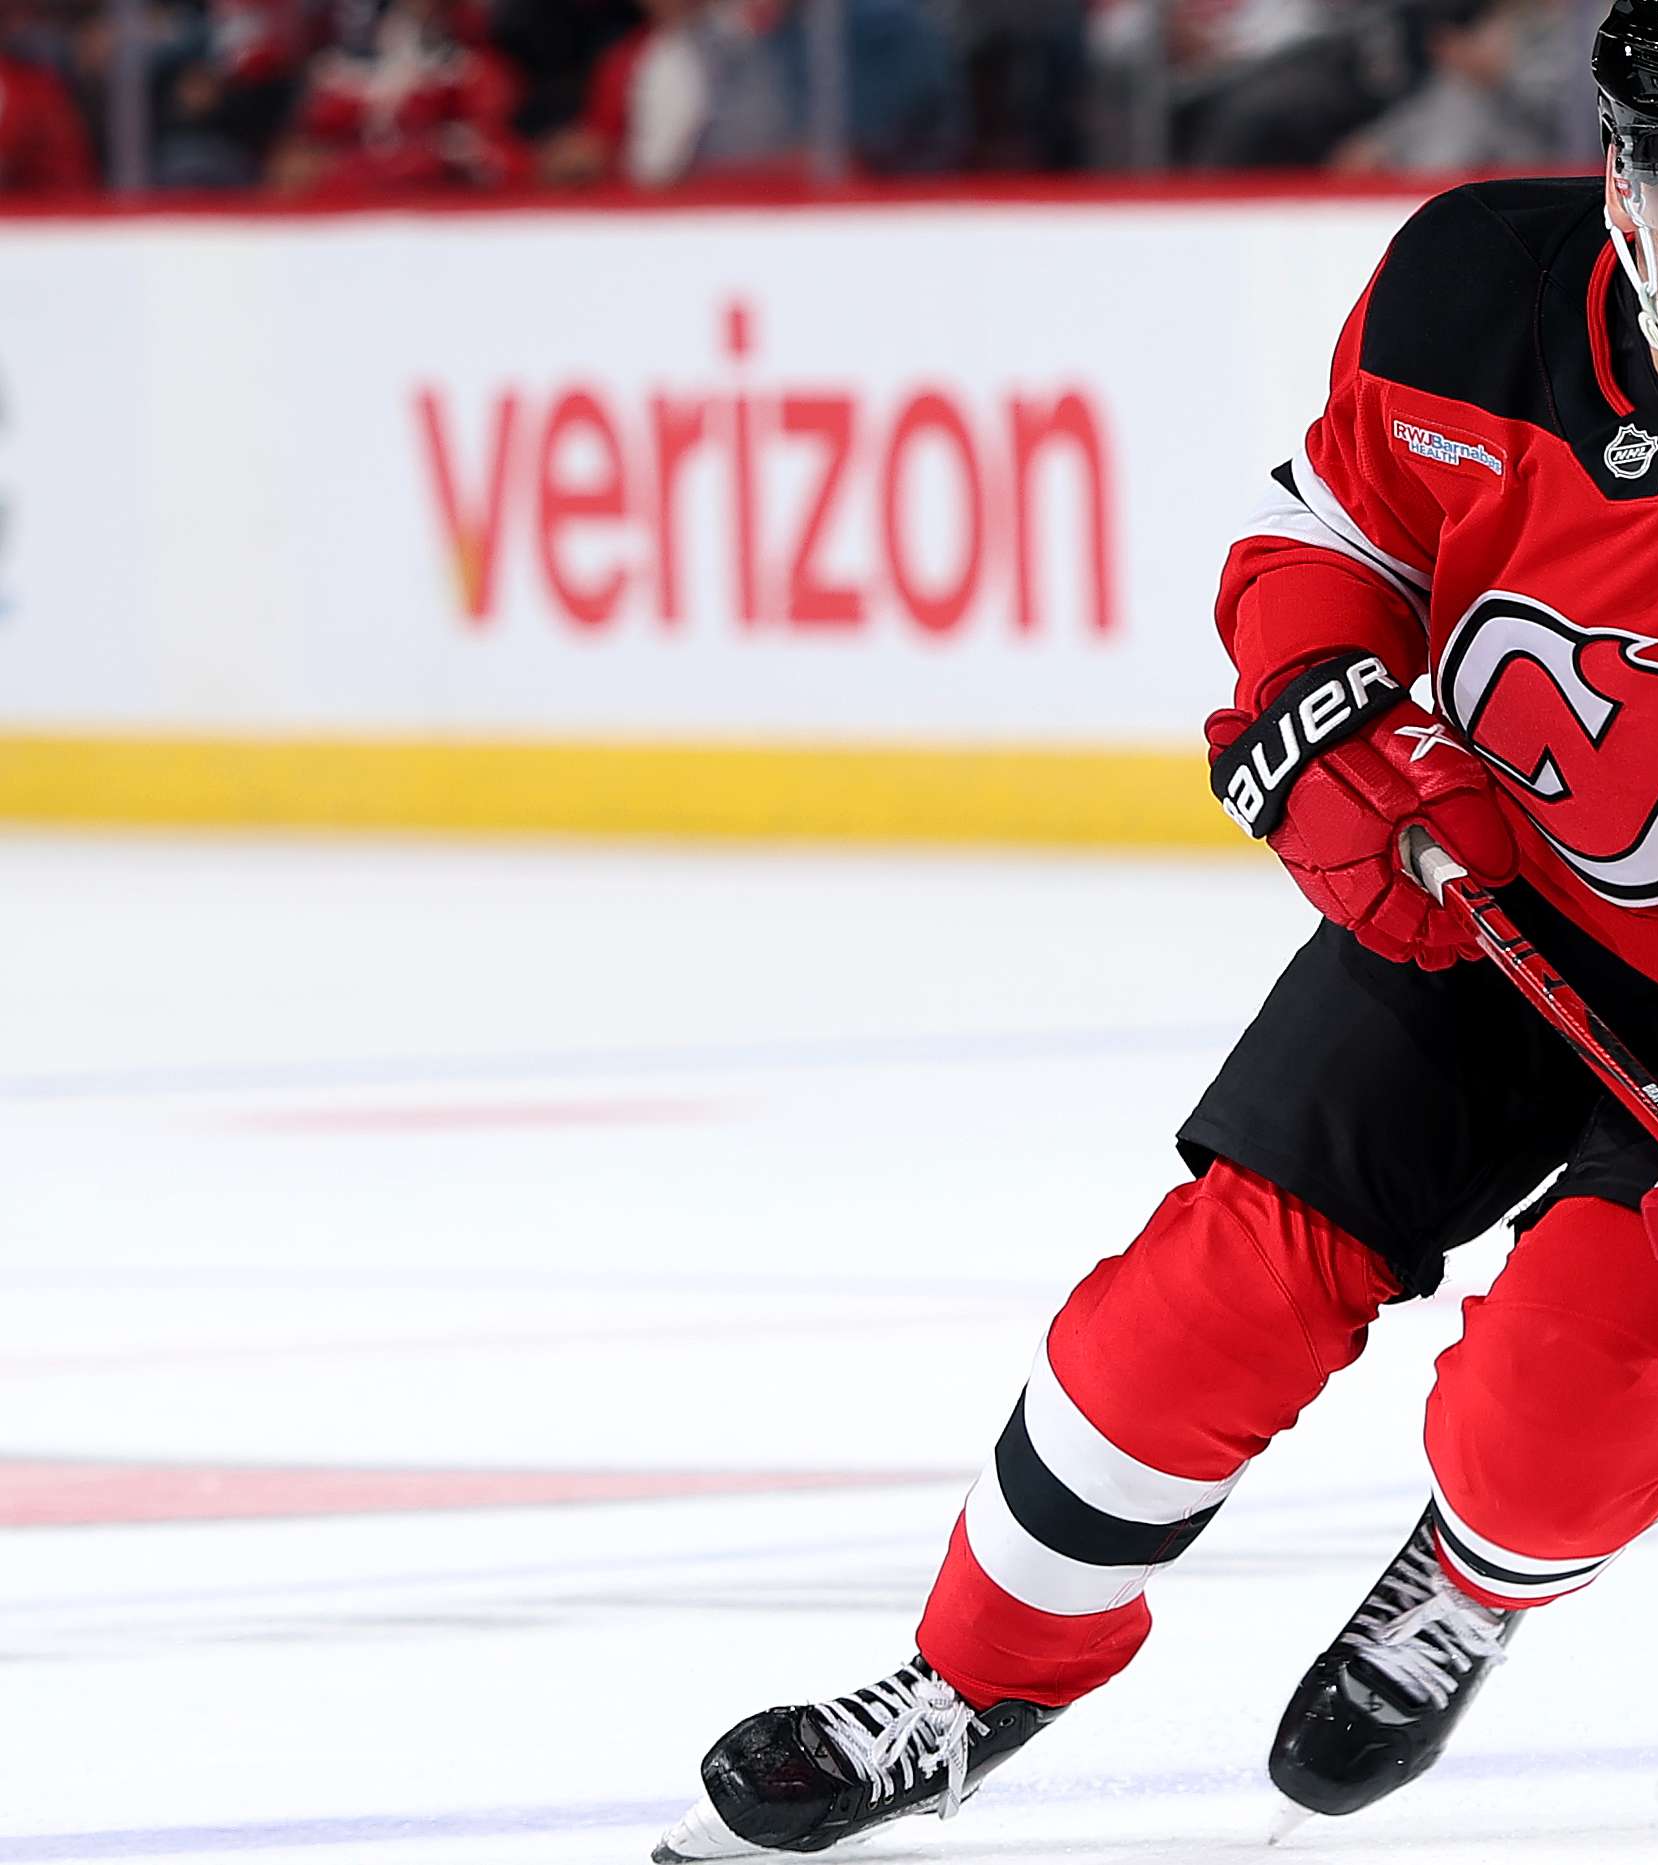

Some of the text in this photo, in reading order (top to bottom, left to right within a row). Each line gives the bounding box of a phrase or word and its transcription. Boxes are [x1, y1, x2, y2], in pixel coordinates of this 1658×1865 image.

[415, 300, 1120, 633] verizon
[1394, 421, 1503, 475] RWJBarnabas
[1411, 443, 1459, 465] HEALTH
[1612, 446, 1646, 461] NHL
